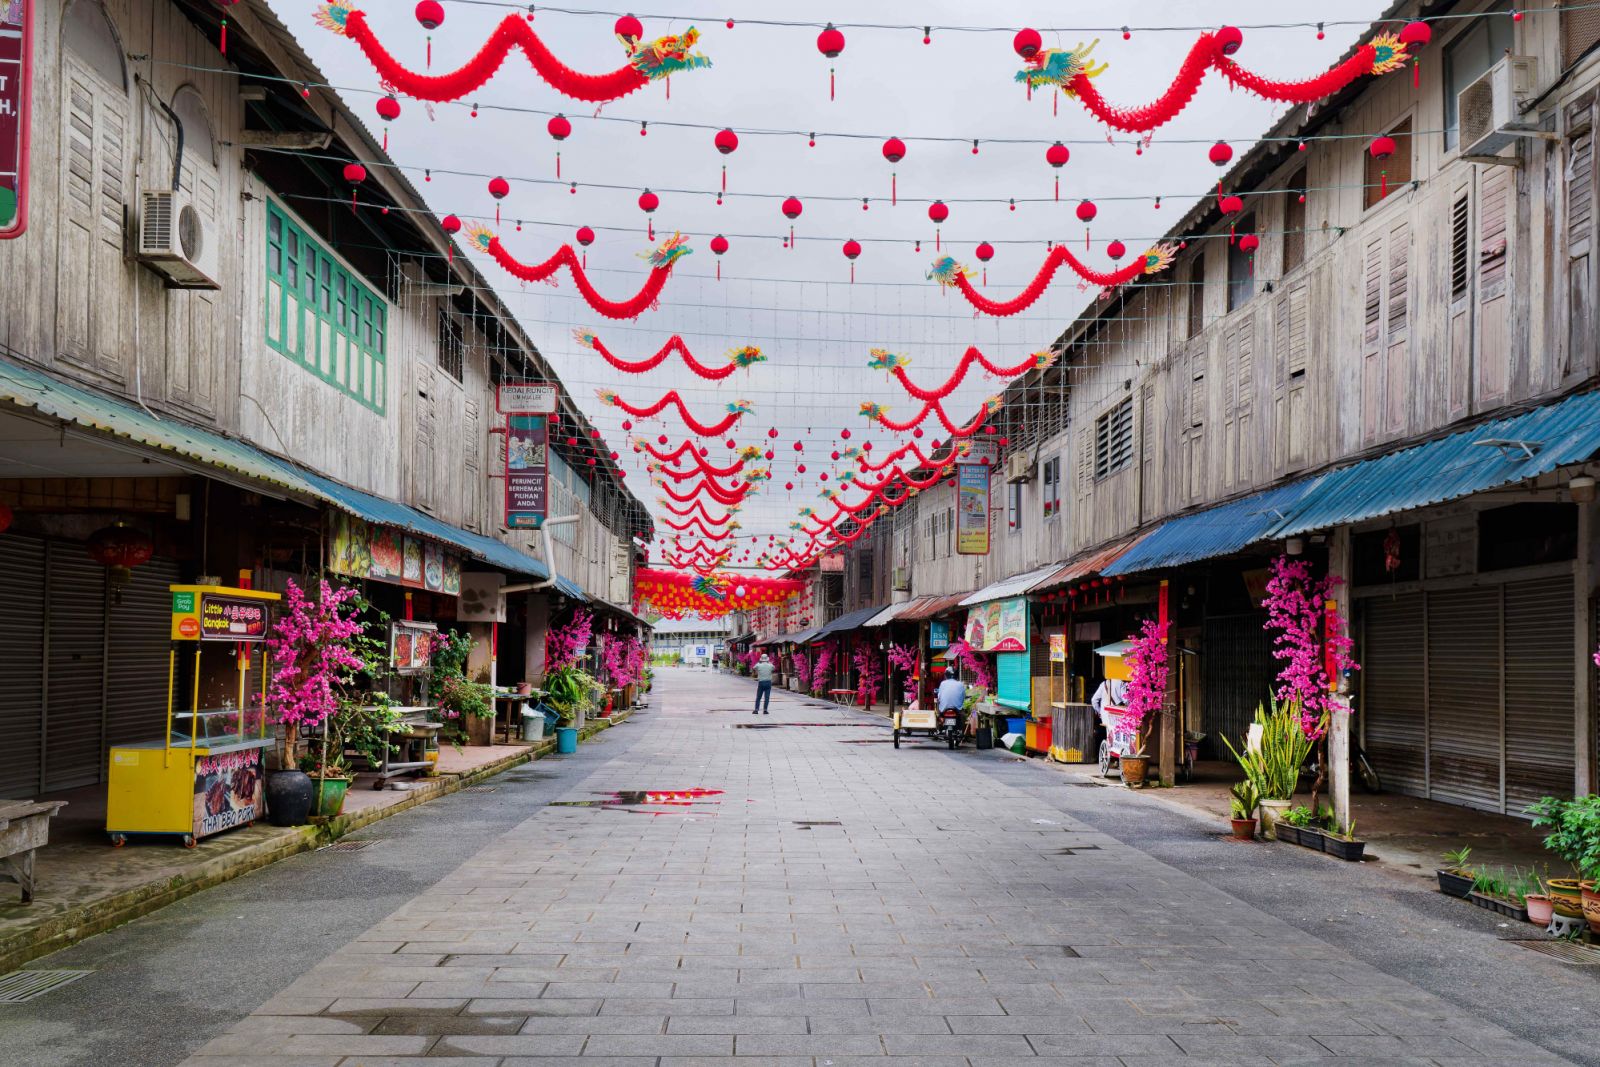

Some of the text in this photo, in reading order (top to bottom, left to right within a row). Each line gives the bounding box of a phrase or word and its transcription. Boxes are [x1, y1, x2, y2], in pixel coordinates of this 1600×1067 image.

[177, 603, 190, 611] Pay
[204, 603, 223, 615] Little
[204, 617, 229, 629] Bangkok
[203, 804, 256, 835] THAI BBQ PORK
